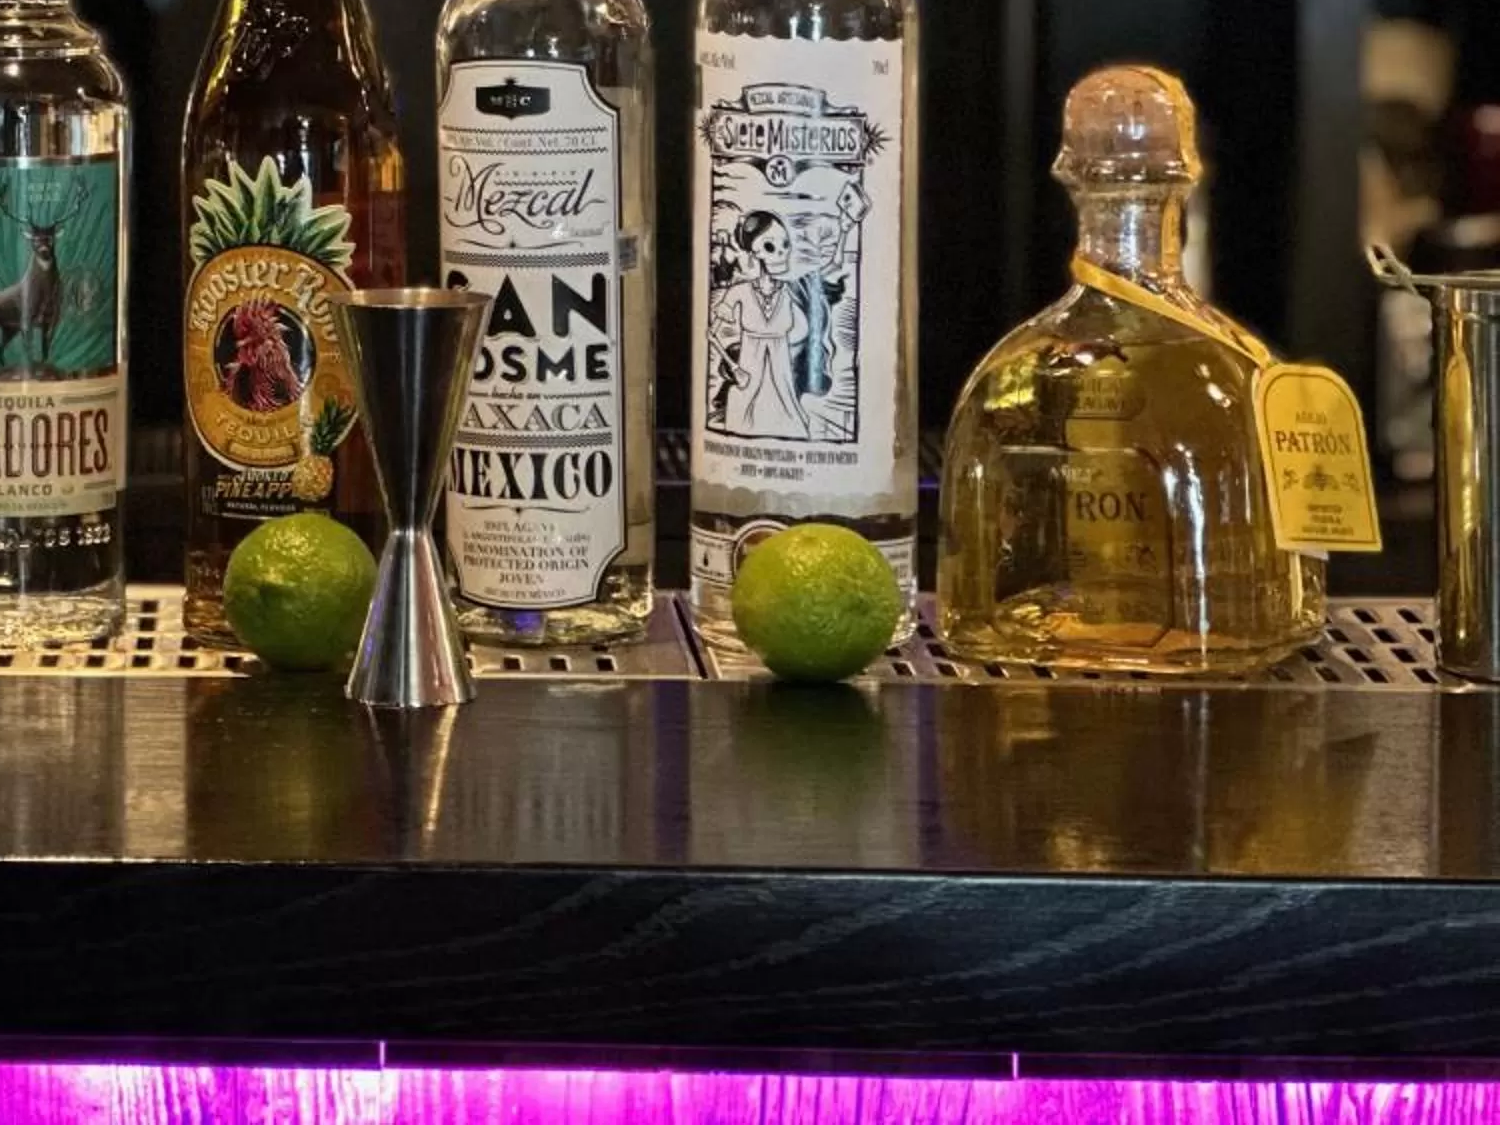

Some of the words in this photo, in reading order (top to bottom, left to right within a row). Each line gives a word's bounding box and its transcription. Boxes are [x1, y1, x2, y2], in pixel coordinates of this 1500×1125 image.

[444, 155, 606, 235] Mezcal
[447, 271, 607, 338] AN
[473, 344, 609, 383] OSME
[462, 402, 612, 431] AXACA
[1275, 427, 1353, 455] PATRÓN
[215, 480, 293, 499] PINEAPP
[1070, 489, 1148, 523] RON
